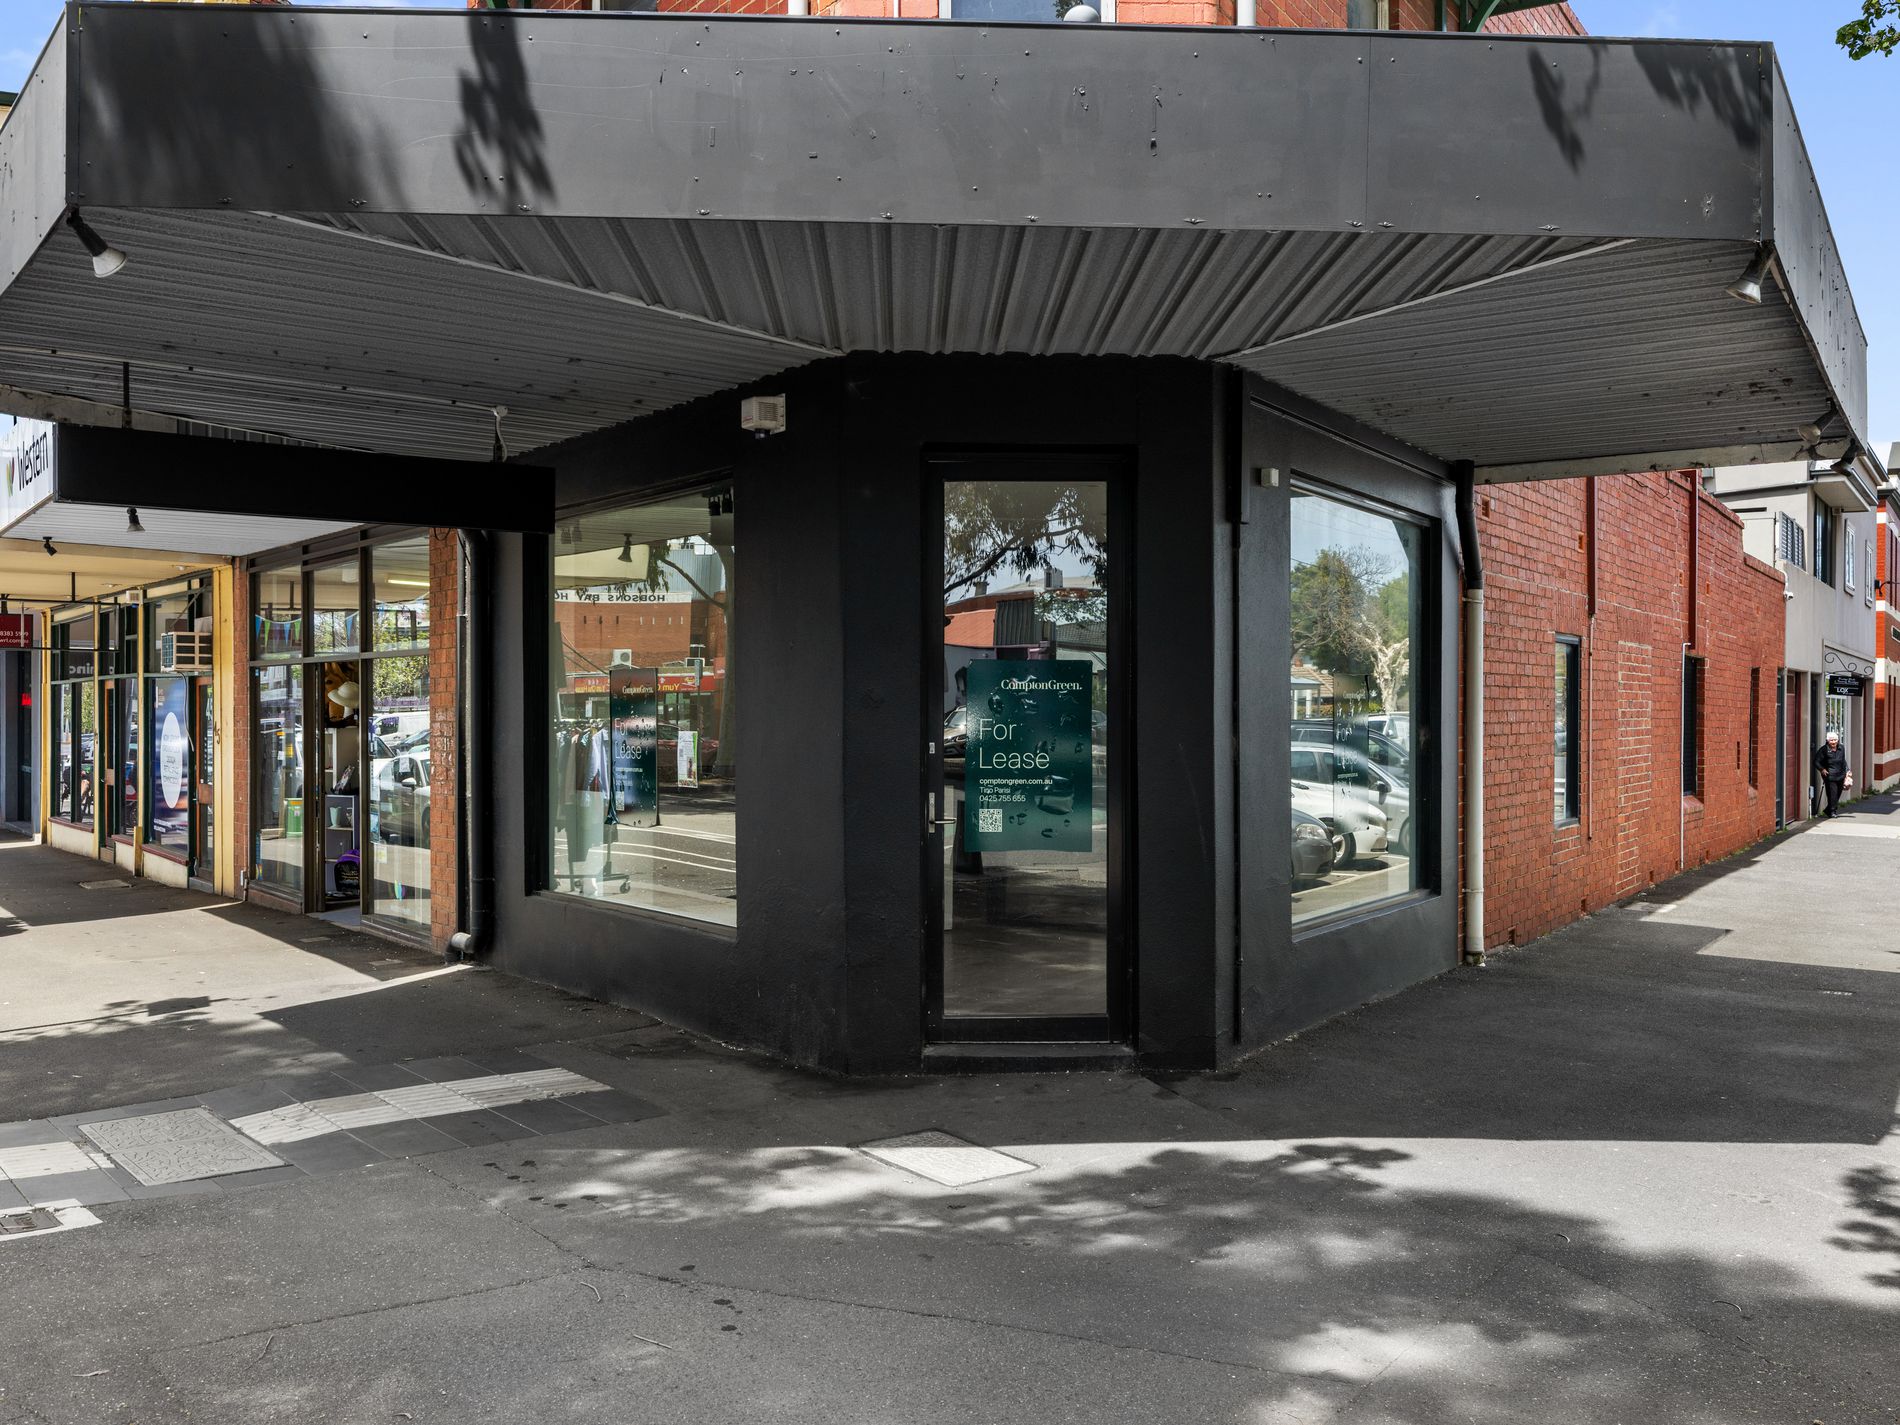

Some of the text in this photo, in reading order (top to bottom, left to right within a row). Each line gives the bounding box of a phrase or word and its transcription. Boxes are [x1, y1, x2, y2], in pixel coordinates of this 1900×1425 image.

[17, 432, 48, 491] Western
[1001, 679, 1082, 692] ComptonGreen.
[980, 718, 1017, 740] For
[980, 747, 1050, 769] Lease
[979, 778, 1053, 786] comptongreen.com.au
